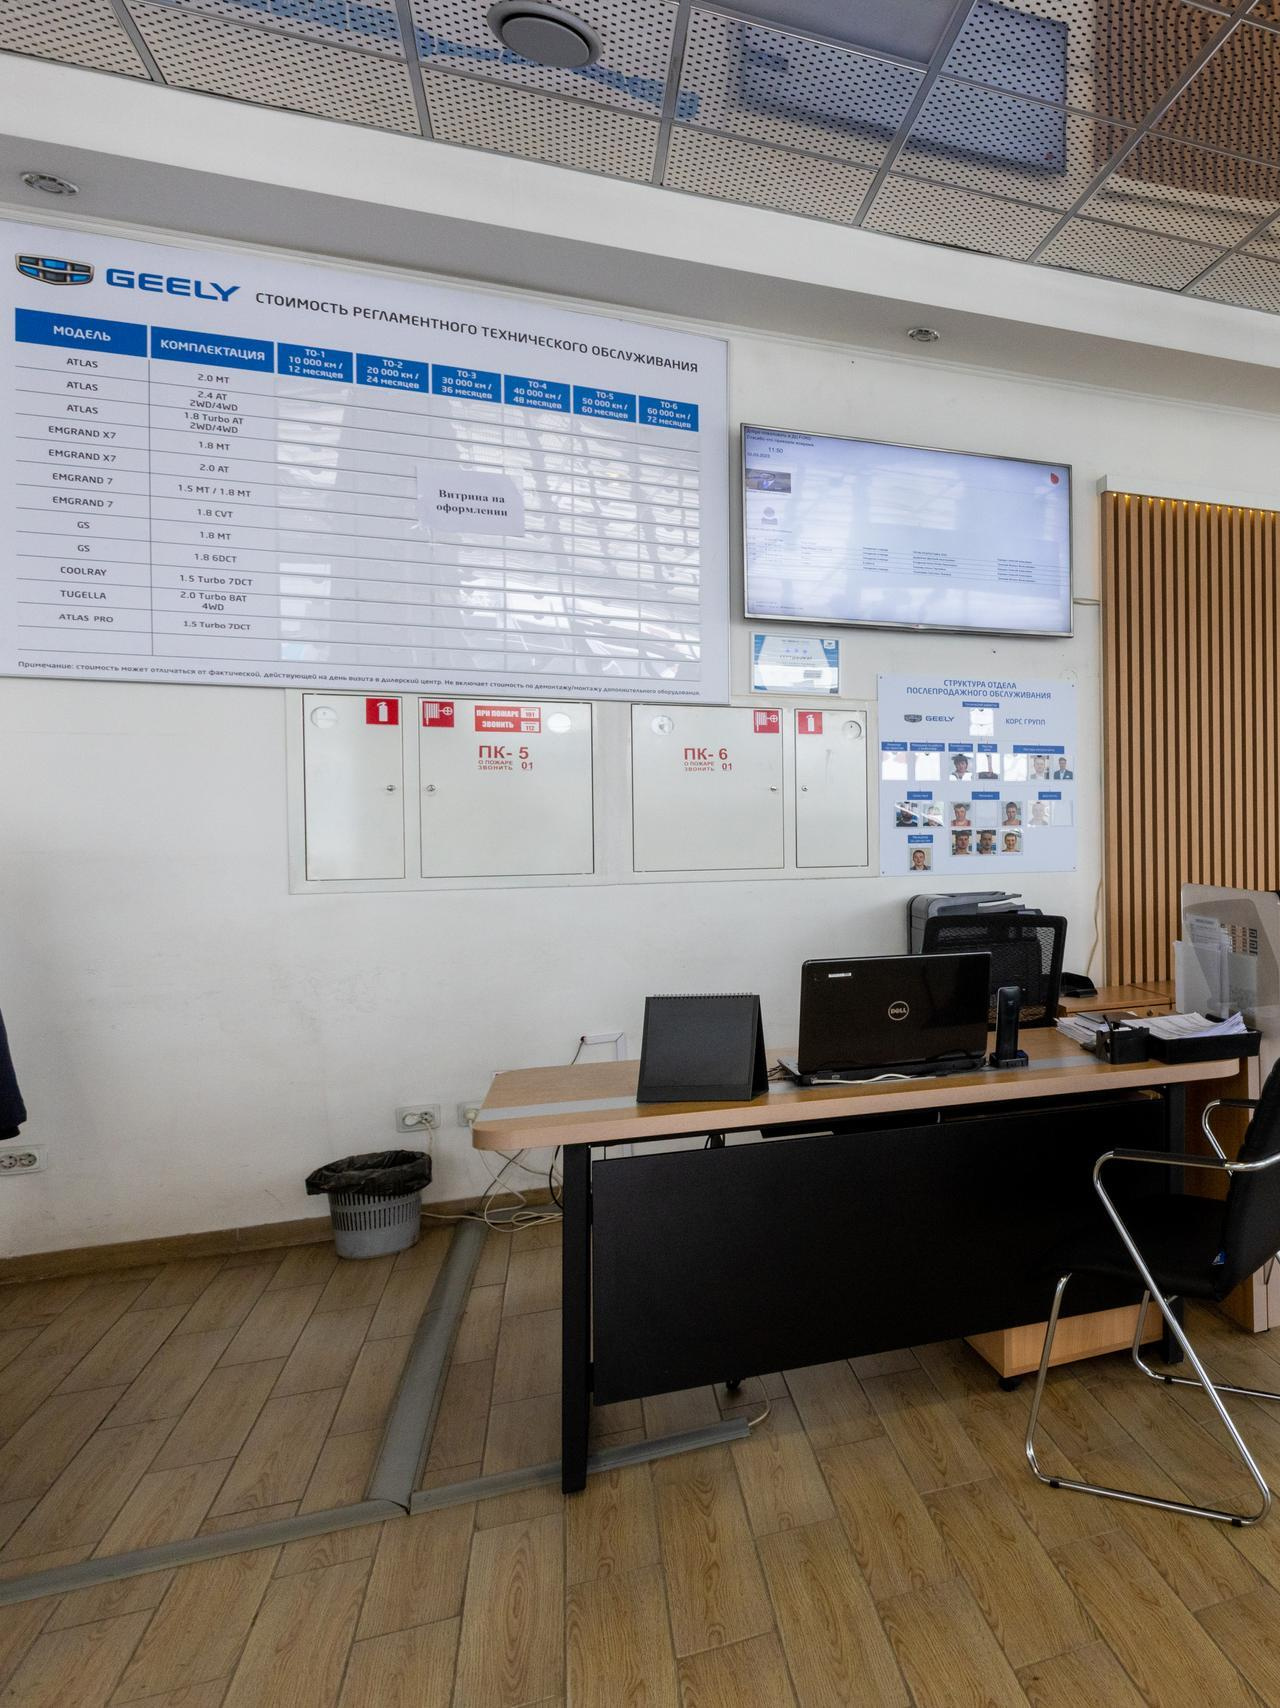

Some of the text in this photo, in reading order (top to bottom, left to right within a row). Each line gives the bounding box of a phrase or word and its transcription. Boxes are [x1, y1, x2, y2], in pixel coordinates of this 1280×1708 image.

[106, 268, 240, 302] GEELY
[54, 325, 111, 342] МОДЕЛЬ
[255, 293, 698, 373] СТОИМОСТЬ РЕГЛАМЕНТНОГО ТЕХНИЧЕСКОГО ОБСЛУЖИВАНИЯ
[160, 339, 265, 362] КОМПЛЕКТАЦИЯ
[305, 349, 325, 358] ТО-1
[66, 358, 98, 368] ATLAS
[289, 356, 337, 369] 10 000 км
[382, 359, 403, 368] ТО-2
[288, 365, 344, 379] 12 месяцев
[367, 367, 378, 375] 20
[380, 369, 399, 377] 000
[457, 370, 477, 379] ТО-3
[216, 376, 230, 384] MT
[381, 378, 419, 389] месяцев
[442, 377, 487, 390] 30 000 км
[67, 381, 98, 391] ATLAS
[528, 381, 547, 390] ТО-4
[197, 391, 213, 399] 2.4
[442, 386, 492, 399] 36 месяцев
[526, 390, 543, 398] 000
[595, 391, 614, 400] ТО-5
[67, 404, 98, 414] ATLAS
[190, 400, 238, 411] 2WD/4WD
[526, 399, 562, 409] месяцев
[595, 400, 610, 408] 000
[660, 401, 678, 409] ТО-6
[185, 412, 244, 425] 1.8 Turbo AT
[594, 409, 628, 419] месяцев
[190, 422, 238, 433] 2WD/4WD
[659, 418, 691, 428] месяцев
[48, 425, 117, 440] EMGRAND X7
[49, 449, 116, 462] EMGRAND X7
[200, 464, 229, 473] 2.0 AT
[52, 473, 113, 485] EMGRAND 7
[178, 484, 193, 493] 1.5
[196, 486, 210, 495] MT
[219, 487, 235, 497] 1.8
[237, 489, 251, 497] MT
[439, 488, 505, 504] Витрина на
[52, 496, 103, 508] EMGRAND
[197, 509, 233, 519] 1.8 CVT
[436, 503, 508, 517] оформлении
[77, 521, 90, 529] GS
[200, 531, 231, 541] 1.8 MT
[77, 544, 90, 552] GS
[194, 553, 237, 564] 1.8 6DCT
[60, 566, 107, 577] COOLRAY
[180, 575, 252, 587] 1.5 Turbo 7DCT
[60, 590, 107, 600] TUGELLA
[180, 591, 196, 600] 2.0
[198, 592, 227, 602] Turbo
[202, 602, 224, 611] 4WD
[59, 614, 113, 623] ATLAS PRO
[184, 620, 251, 631] 1.5 Turbo 7DCT
[18, 661, 74, 670] Примечание:
[208, 670, 261, 678] фактической,
[263, 671, 317, 681] действующей
[944, 679, 986, 688] СТРУКТУРА
[906, 687, 1051, 699] ПОСЛЕПРОДАЖНОГО ОБСЛУЖИВАНИЯ
[492, 710, 519, 718] ПОЖАРЕ
[1025, 718, 1046, 726] ГРУПП
[479, 746, 529, 759] ПК- 5
[684, 748, 728, 760] ПК- 6
